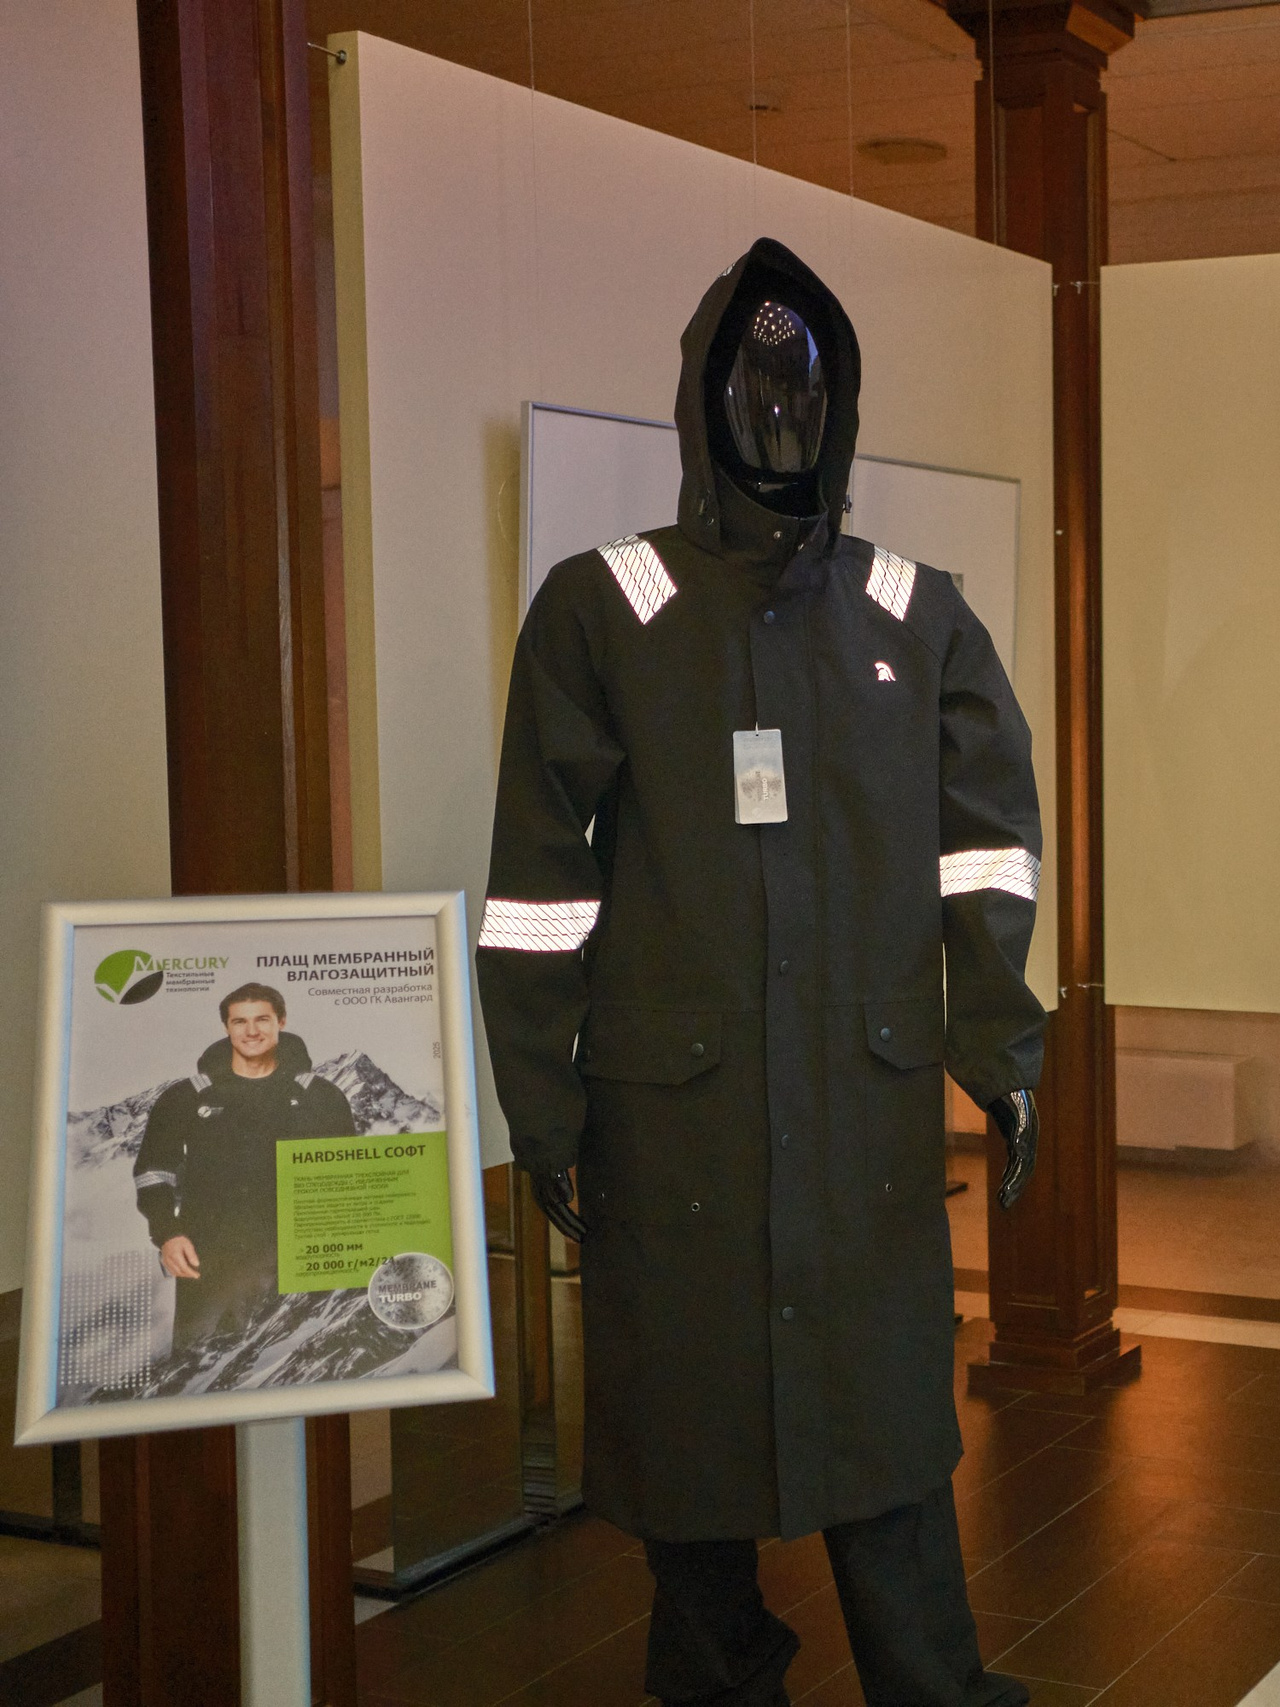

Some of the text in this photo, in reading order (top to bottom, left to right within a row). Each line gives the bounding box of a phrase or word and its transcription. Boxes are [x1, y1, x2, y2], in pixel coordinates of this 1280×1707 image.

[134, 956, 230, 971] MERCURY
[256, 947, 435, 968] ПЛАЩ МЕМБРАННЫЙ
[287, 963, 435, 982] ВЛАГОЗАЩИТНЫЙ
[308, 984, 433, 997] Совместная разработка
[342, 996, 367, 1006] ООО
[369, 996, 382, 1004] ГК
[385, 993, 433, 1005] Авангард
[432, 1041, 441, 1059] 2025
[293, 1145, 426, 1164] HARDSHELL СОФТ
[306, 1245, 319, 1254] 20
[323, 1243, 344, 1253] 000
[306, 1262, 320, 1271] 20
[323, 1260, 344, 1270] 000
[378, 1280, 437, 1293] MEMBRANE
[379, 1292, 422, 1303] TURBO
